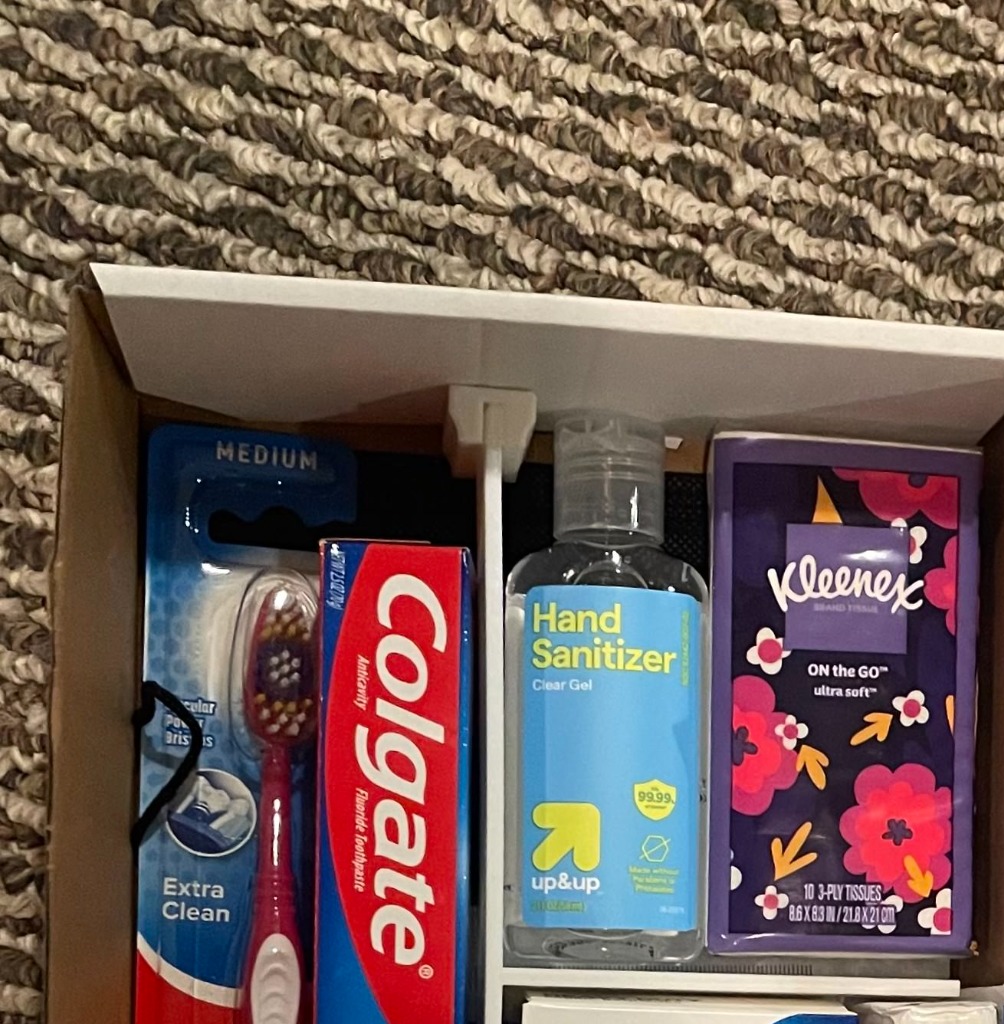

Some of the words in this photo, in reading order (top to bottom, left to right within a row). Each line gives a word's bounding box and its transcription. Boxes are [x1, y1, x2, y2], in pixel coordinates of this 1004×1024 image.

[216, 440, 317, 470] MEDIUM
[767, 554, 924, 614] Kleenex
[532, 602, 622, 634] Hand
[532, 637, 677, 674] Sanitizer
[807, 664, 829, 677] ON
[832, 664, 856, 677] the
[353, 654, 370, 711] Anticavity
[532, 679, 566, 691] Clear
[569, 679, 592, 691] Gel
[814, 685, 843, 697] ultra
[355, 787, 368, 829] Fluoride
[352, 830, 367, 893] Toothpaste
[162, 877, 225, 898] Extra
[531, 872, 600, 895] up&up
[804, 883, 815, 900] 10
[818, 884, 845, 900] 3-PLY
[846, 884, 882, 901] TISSUES
[162, 902, 230, 922] Clean
[803, 905, 811, 922] X
[862, 906, 869, 923] X
[870, 907, 879, 923] 21
